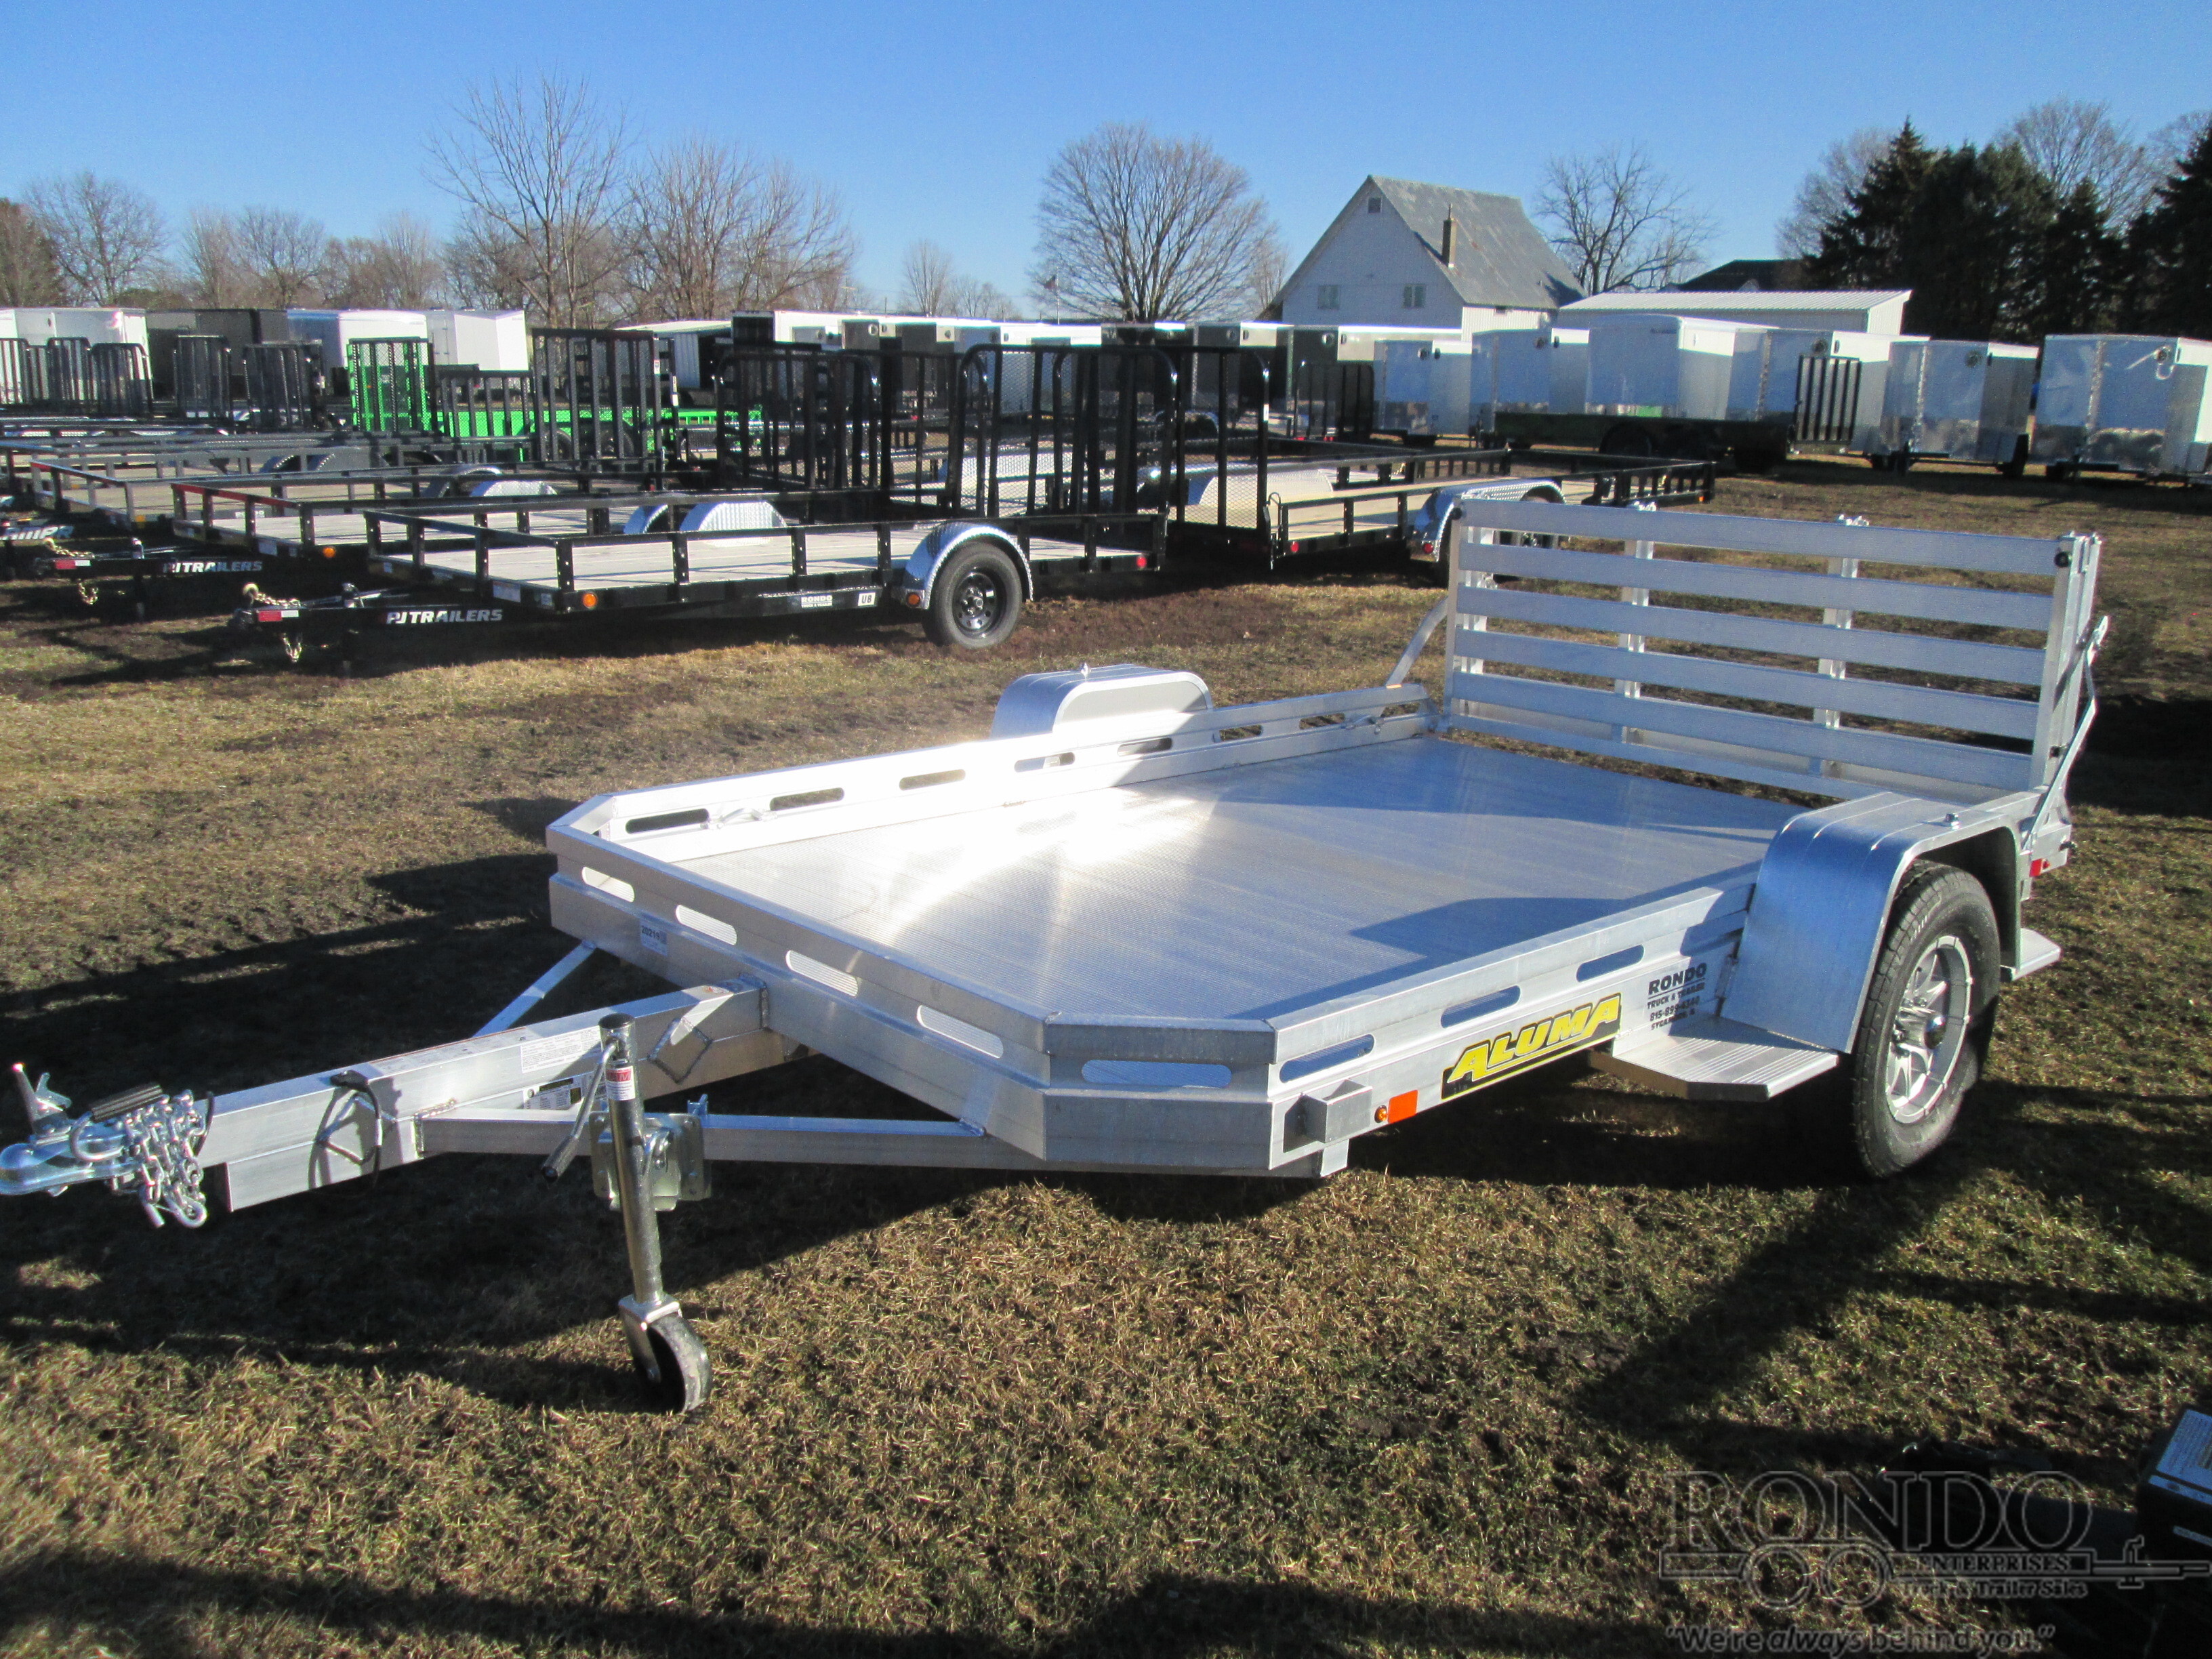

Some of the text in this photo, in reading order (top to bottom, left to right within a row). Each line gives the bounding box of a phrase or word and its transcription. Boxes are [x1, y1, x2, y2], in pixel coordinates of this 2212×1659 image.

[1648, 962, 1707, 995] RONDO
[1647, 994, 1670, 1009] TRUCK
[1447, 994, 1620, 1083] ALUMA
